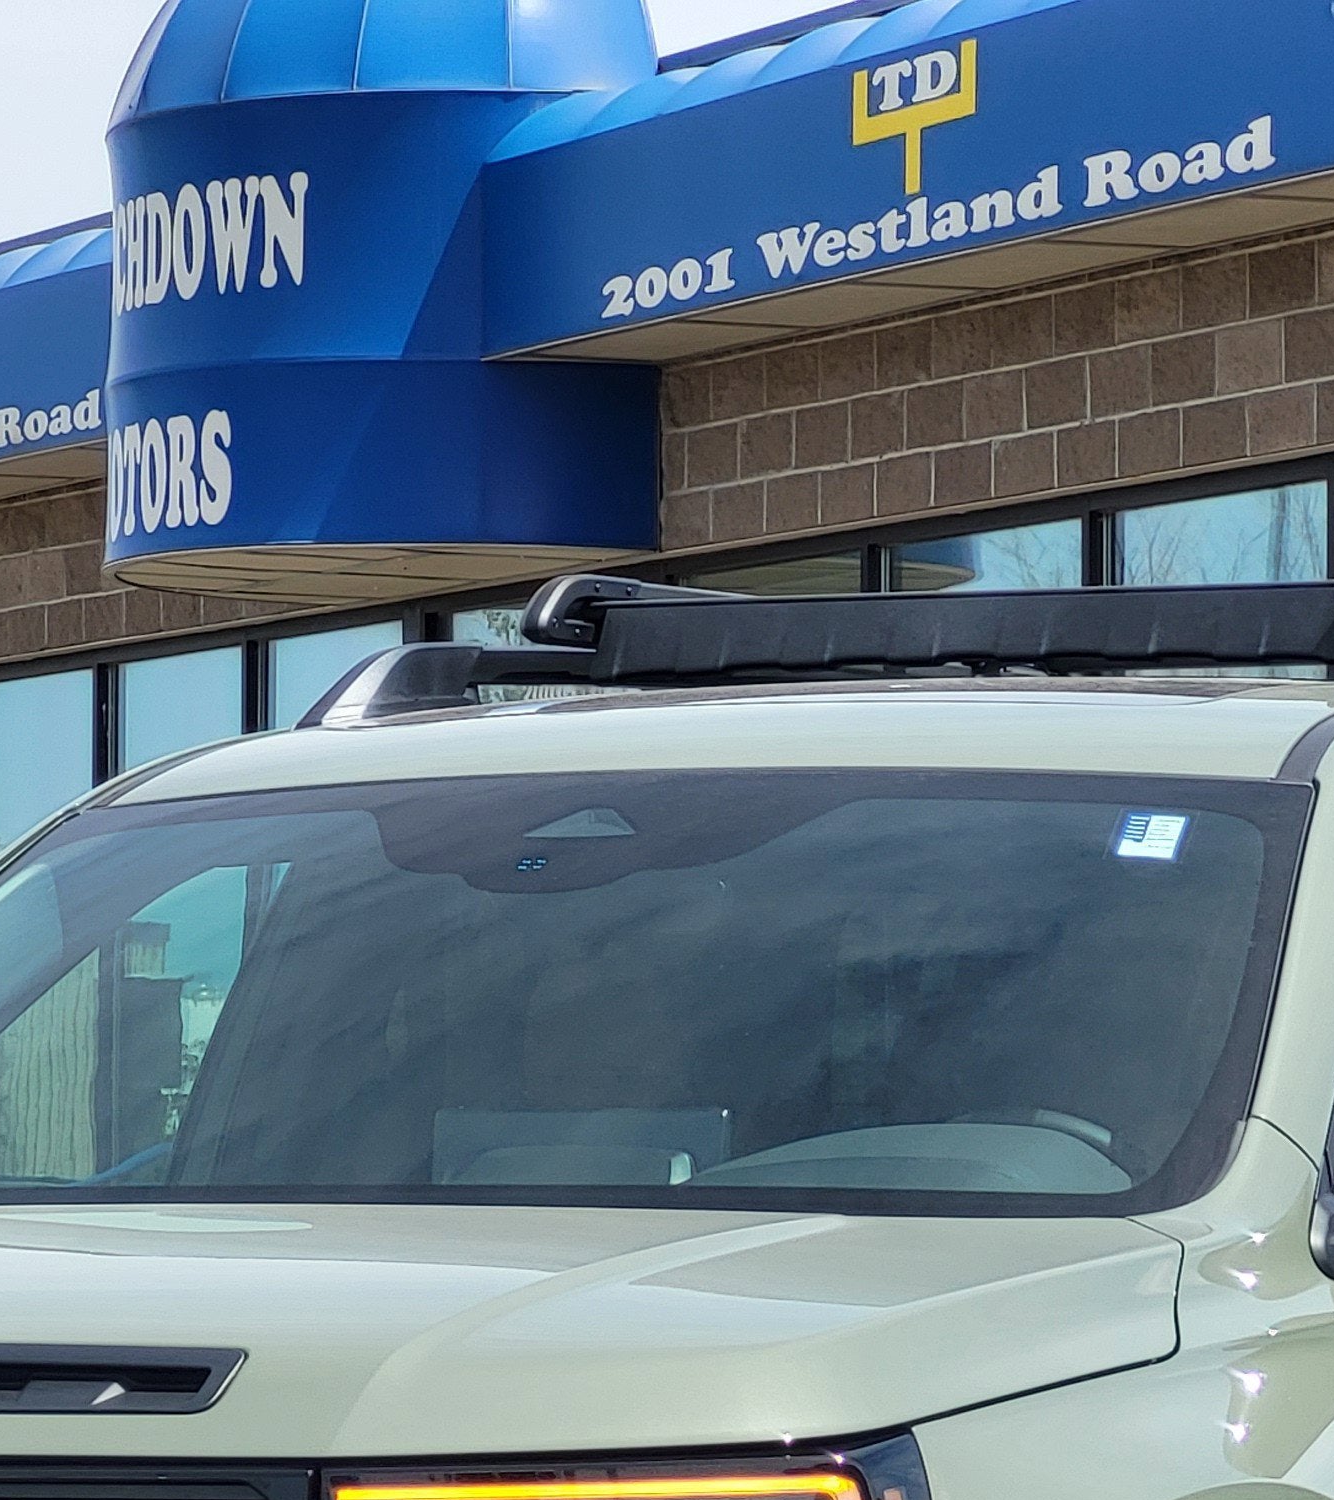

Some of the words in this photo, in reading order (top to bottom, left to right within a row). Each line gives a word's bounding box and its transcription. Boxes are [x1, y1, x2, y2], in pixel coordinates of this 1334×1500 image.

[871, 50, 957, 112] TD
[116, 171, 309, 317] CHDOWN
[601, 247, 735, 319] 2001
[756, 165, 1064, 280] Westland
[1083, 114, 1276, 207] Road
[110, 409, 232, 542] OTORS
